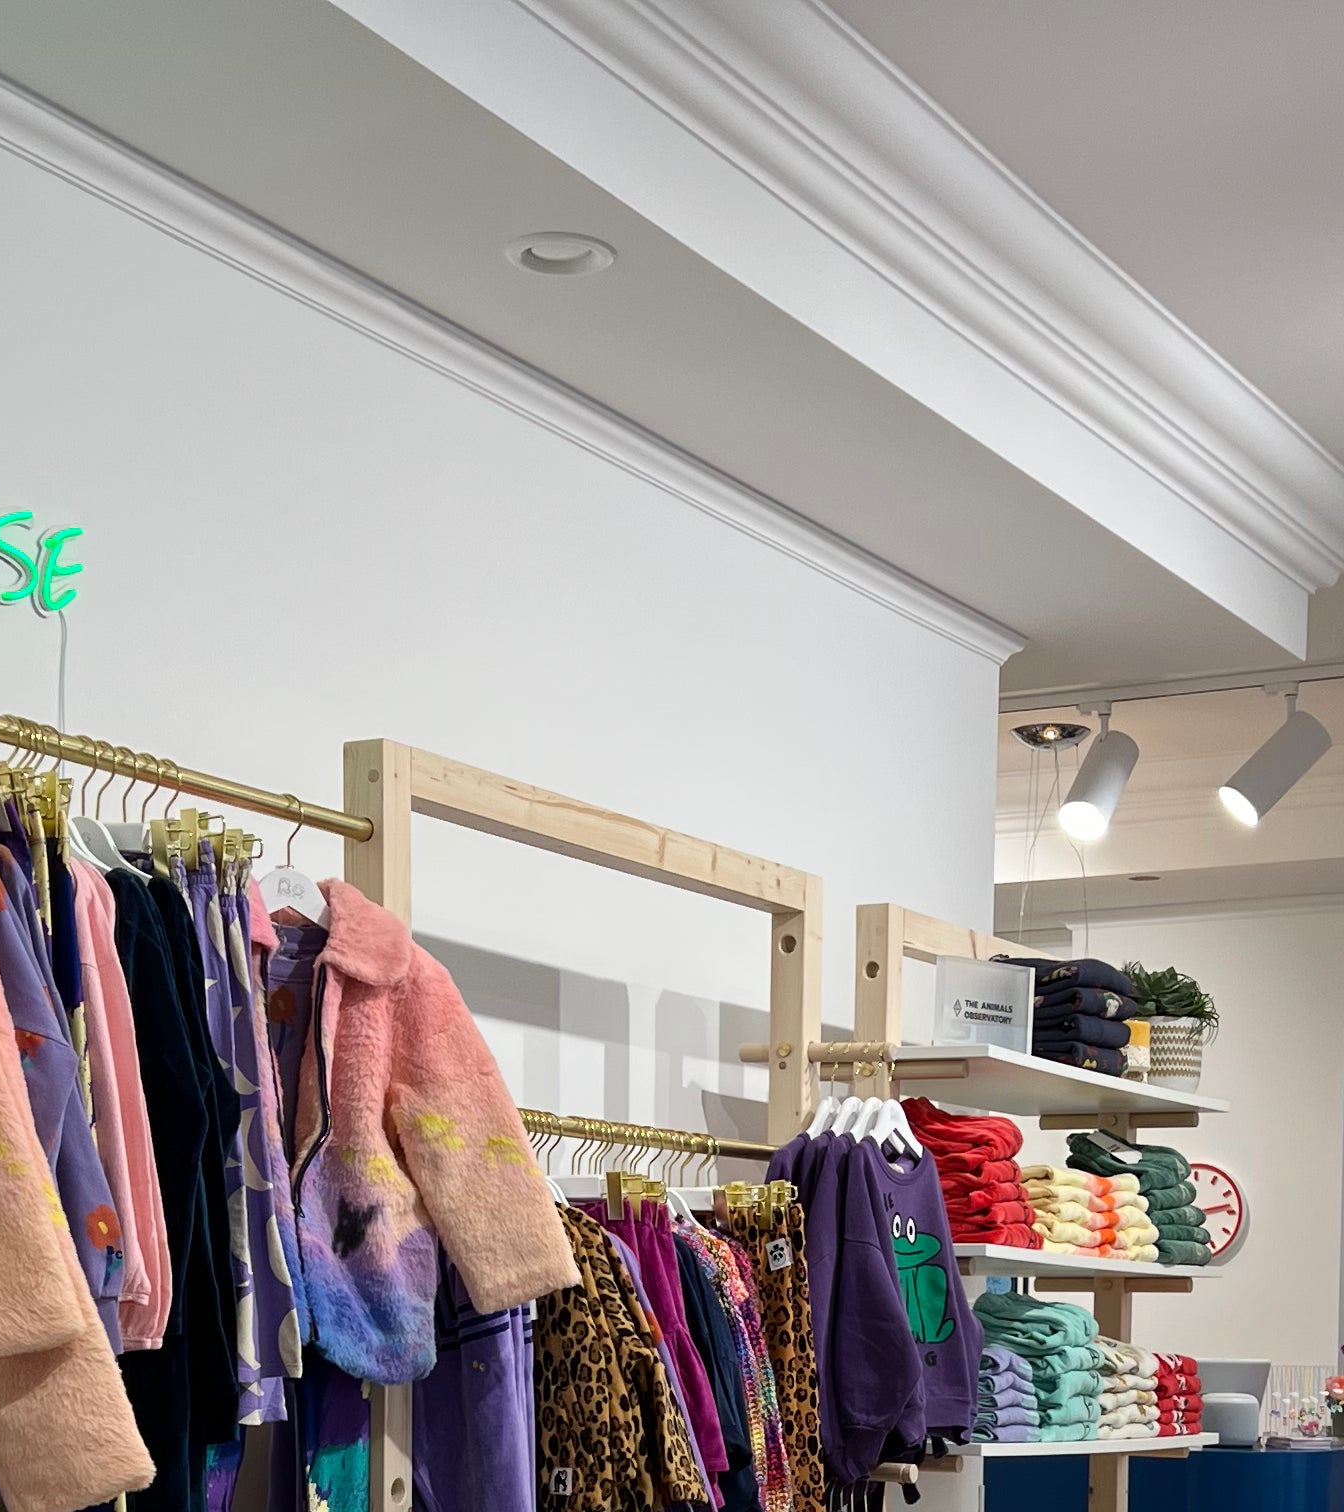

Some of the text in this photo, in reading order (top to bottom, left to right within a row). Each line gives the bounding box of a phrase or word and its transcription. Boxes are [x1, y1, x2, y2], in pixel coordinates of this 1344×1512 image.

[964, 999, 1013, 1013] THE ANIMALS
[964, 1011, 1013, 1024] OBSERVATORY
